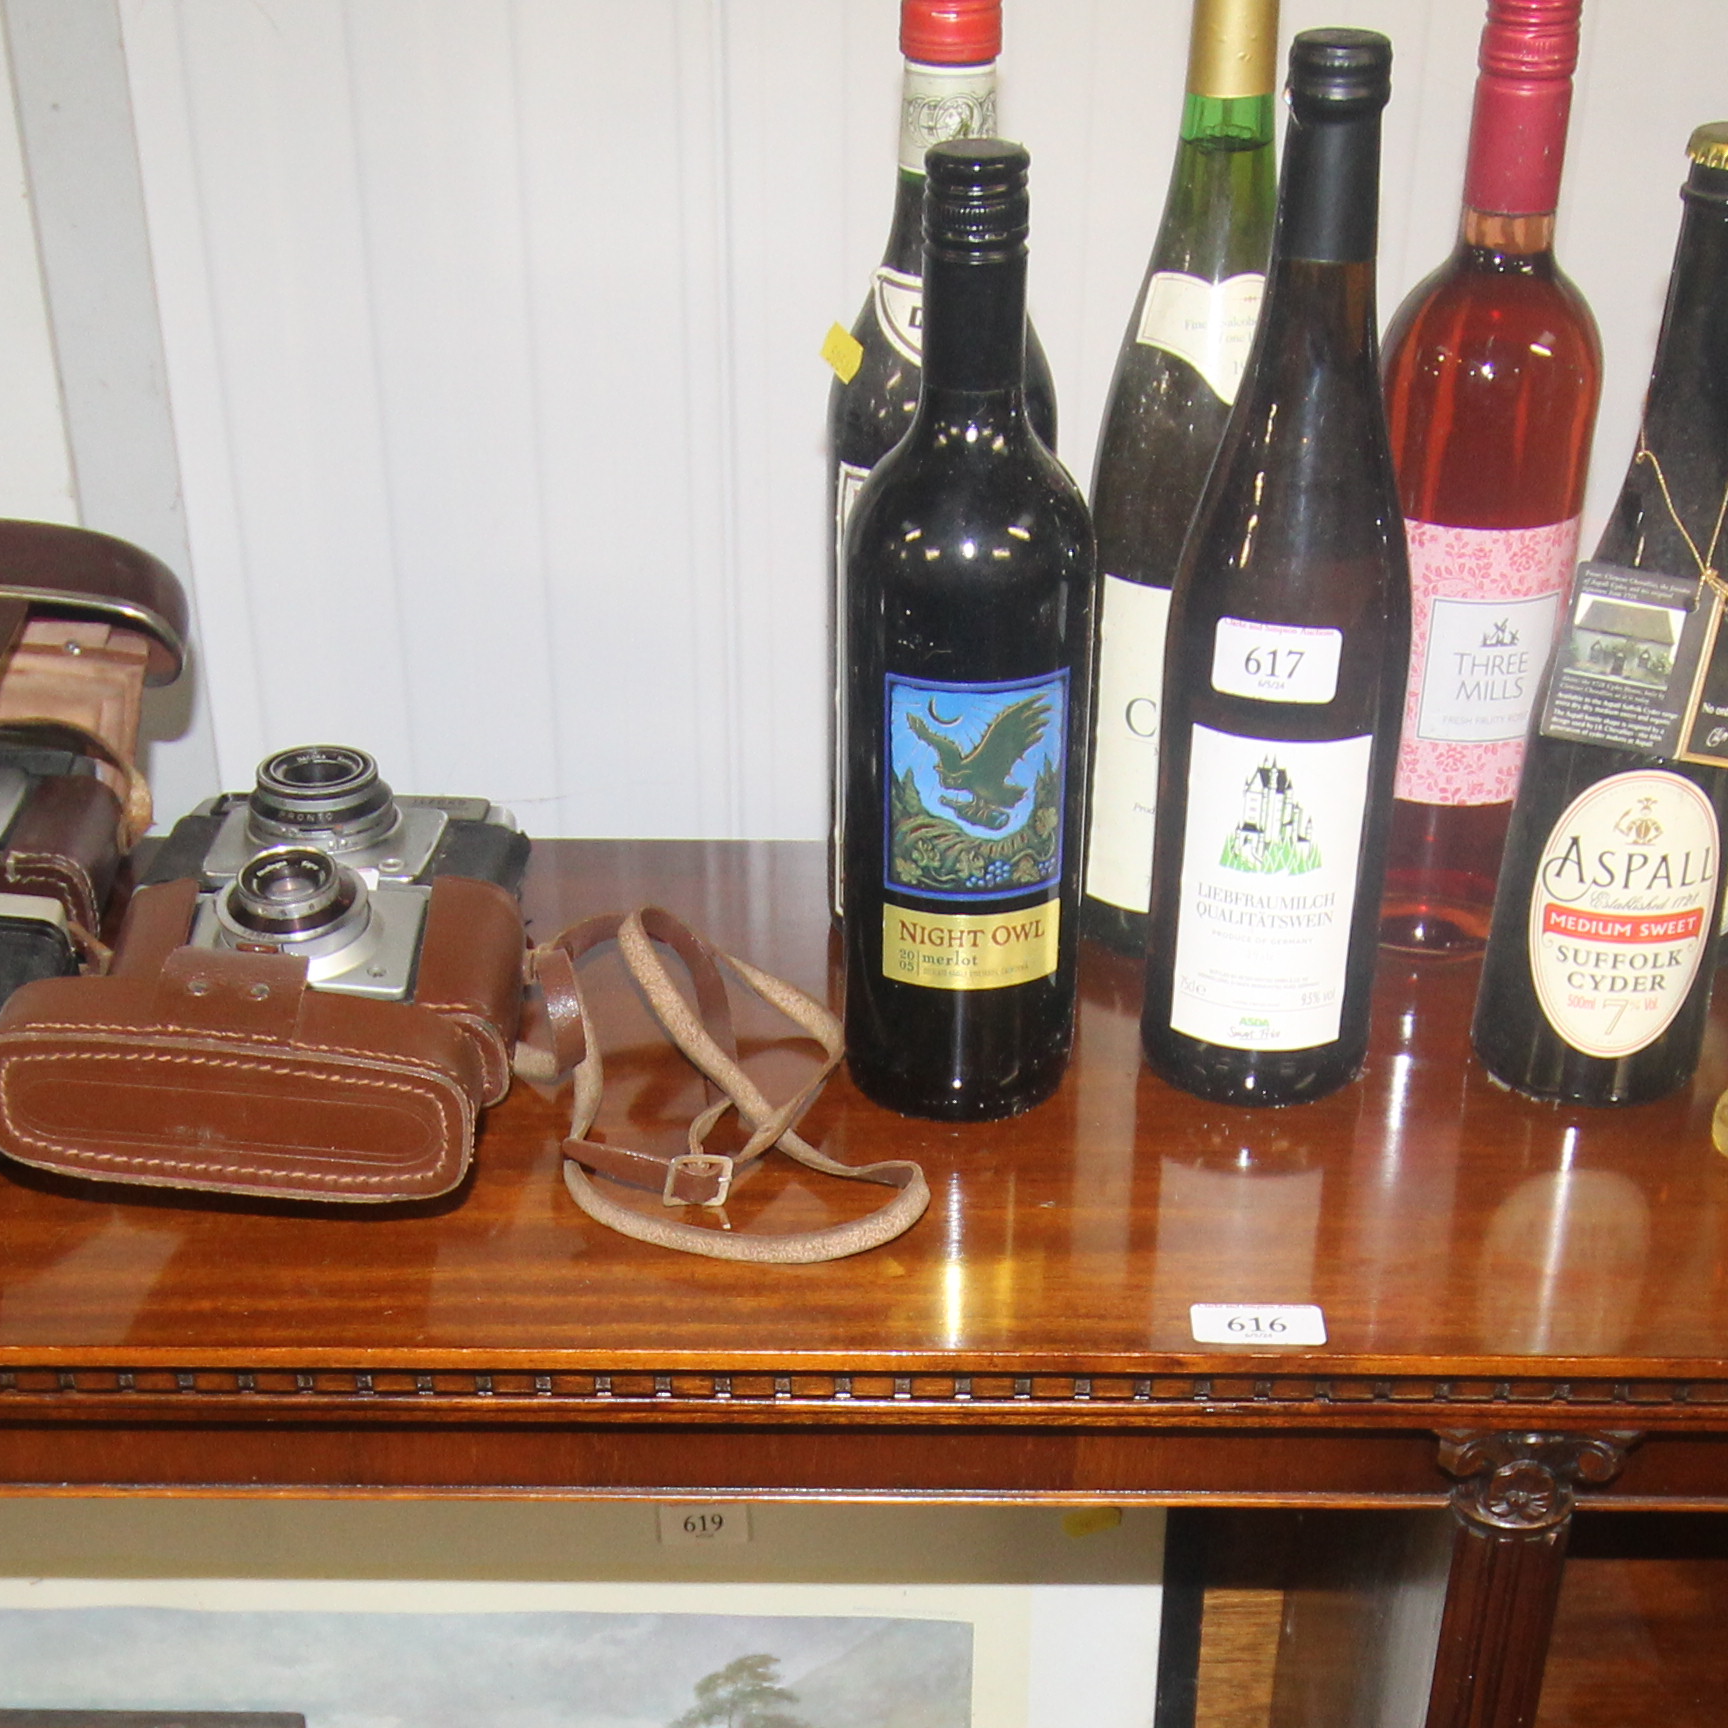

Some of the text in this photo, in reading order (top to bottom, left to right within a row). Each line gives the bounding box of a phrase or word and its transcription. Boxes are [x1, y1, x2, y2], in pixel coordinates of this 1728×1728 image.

[1245, 647, 1305, 679] 617
[1453, 652, 1529, 676] THREE
[1456, 678, 1523, 701] MILLS
[1542, 834, 1714, 902] ASPALL
[1197, 881, 1336, 912] LIEBFRAUMILCH
[1590, 889, 1667, 911] Established
[1196, 901, 1333, 929] QUALITÄTSWEIN
[1549, 911, 1698, 938] MEDIUM SWEET
[899, 919, 1045, 948] NIGHT OWL
[922, 951, 978, 966] merlot
[1556, 944, 1683, 970] SUFFOLK
[1567, 970, 1667, 994] CYDER
[1239, 1017, 1270, 1028] ASDA
[1227, 1316, 1287, 1333] 616
[684, 1513, 724, 1532] 619
